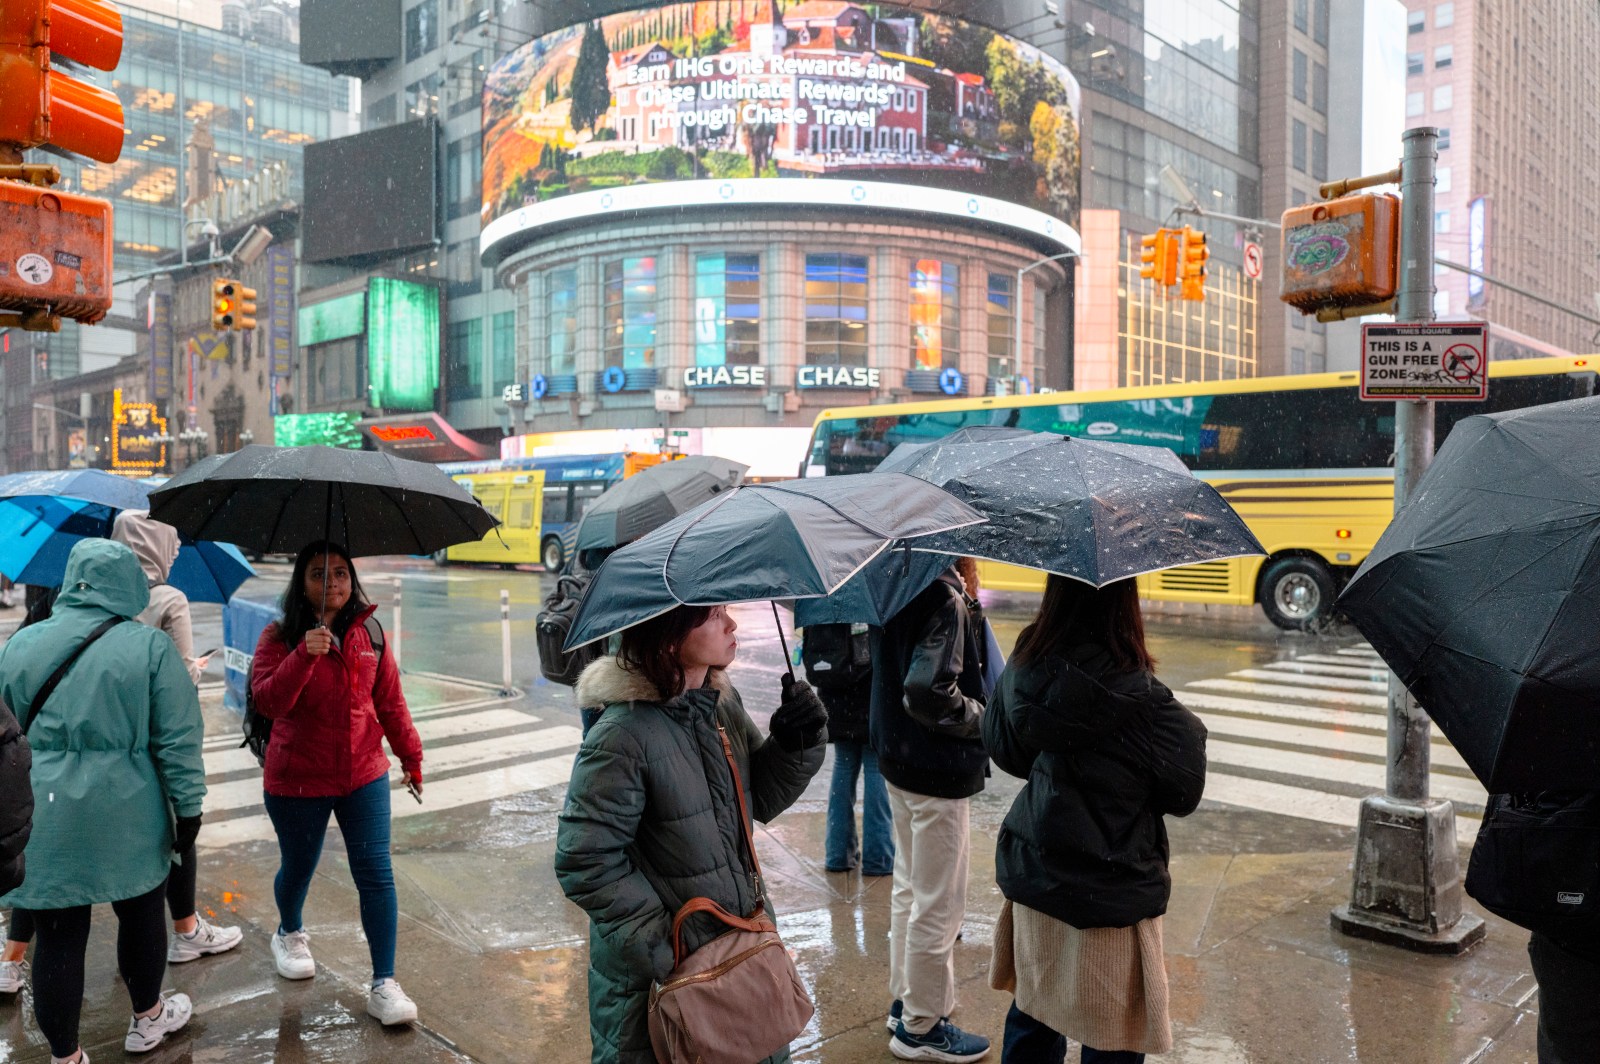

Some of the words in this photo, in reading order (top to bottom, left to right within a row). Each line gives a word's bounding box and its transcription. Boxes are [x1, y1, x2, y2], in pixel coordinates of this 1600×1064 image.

[627, 64, 670, 84] Earn
[676, 57, 713, 79] IHG
[770, 56, 861, 78] Rewards
[867, 62, 905, 82] and
[636, 82, 695, 106] Chase
[701, 79, 791, 101] Ultimate
[655, 105, 736, 130] through
[742, 105, 807, 124] Chase
[813, 105, 876, 128] Travel
[1369, 341, 1400, 352] THIS
[1405, 341, 1418, 352] IS
[1422, 341, 1432, 352] A
[1368, 355, 1398, 365] GUN
[1403, 355, 1439, 365] FREE
[683, 365, 766, 386] CHASE
[798, 366, 880, 387] CHASE
[1369, 369, 1407, 379] ZONE
